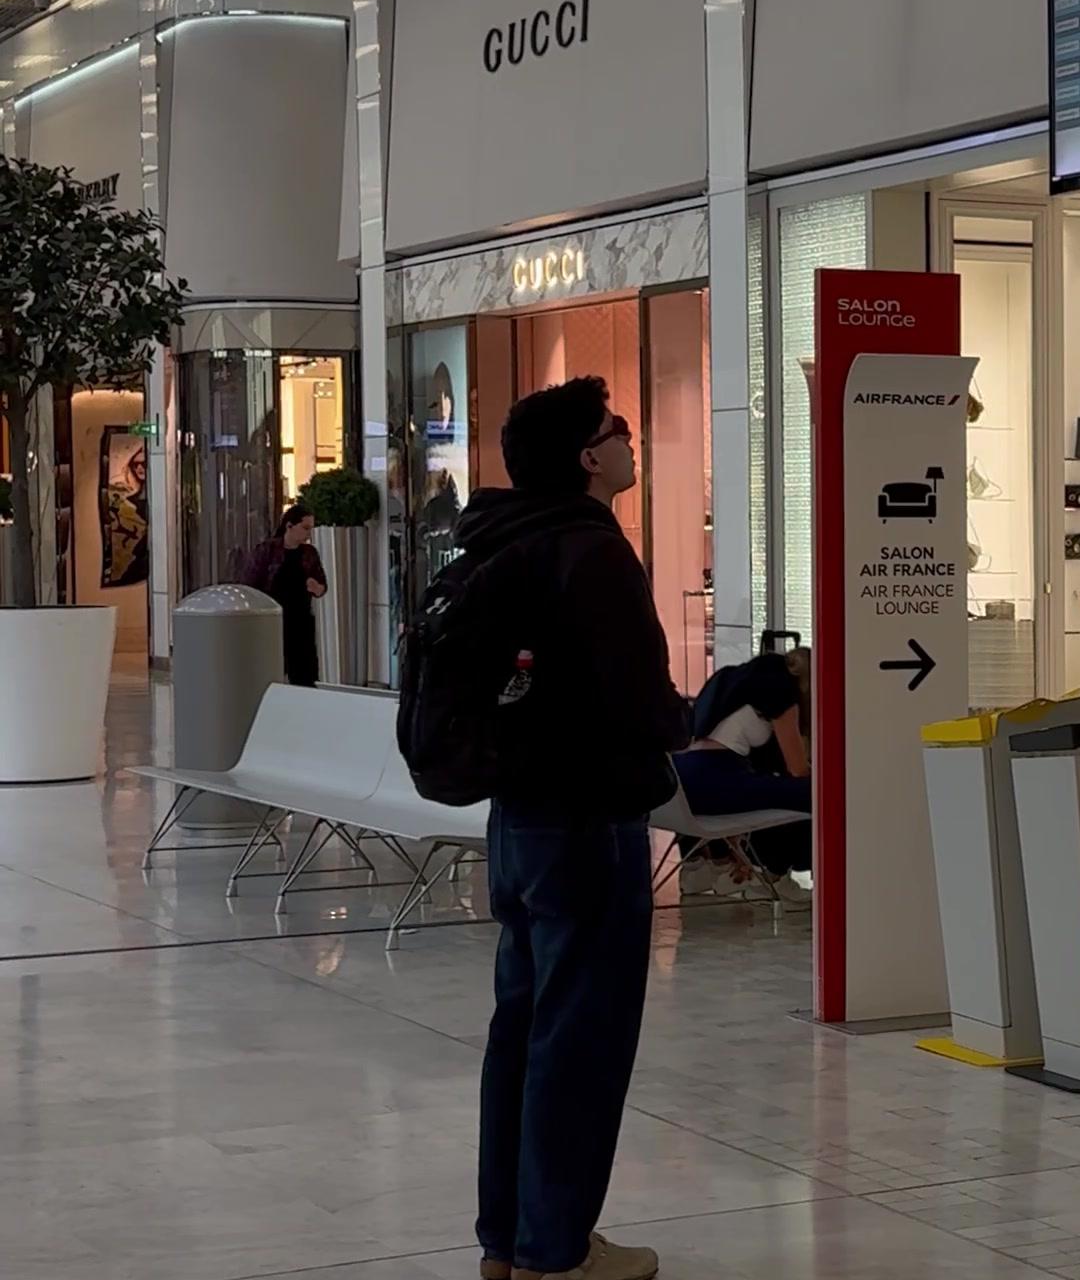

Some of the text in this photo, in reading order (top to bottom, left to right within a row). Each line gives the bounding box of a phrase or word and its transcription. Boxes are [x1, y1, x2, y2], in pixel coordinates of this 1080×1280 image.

[512, 247, 584, 293] GUCCI
[853, 393, 946, 406] AIRFRANCE
[880, 546, 935, 560] SALON
[859, 563, 955, 577] AIR FRANCE
[860, 584, 954, 598] AIR FRANCE
[876, 600, 940, 616] LOUNGE
